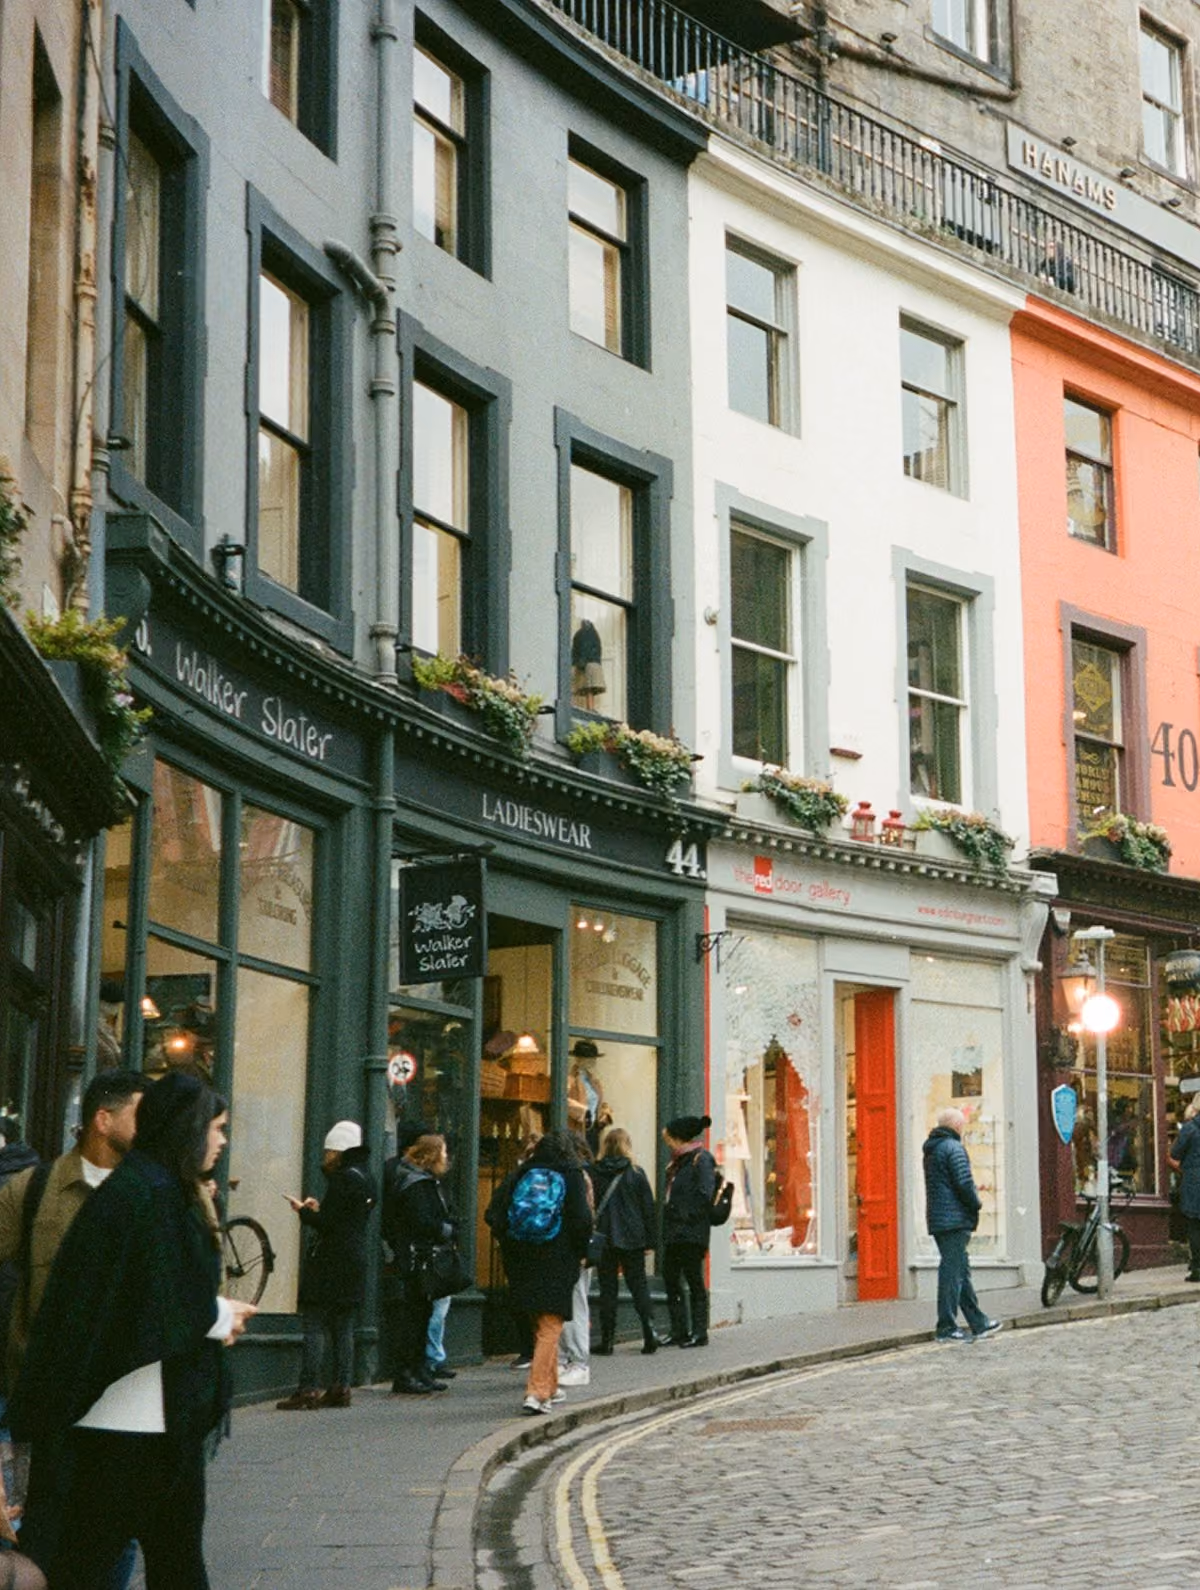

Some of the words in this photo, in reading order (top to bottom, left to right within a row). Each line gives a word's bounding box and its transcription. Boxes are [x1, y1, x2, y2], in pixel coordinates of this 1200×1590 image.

[1022, 140, 1117, 211] HANAMS
[175, 640, 248, 718] Walker
[261, 696, 333, 761] Slater
[1150, 721, 1200, 793] 40
[482, 792, 592, 849] LADIESWEAR
[754, 868, 773, 889] red
[775, 875, 802, 893] door
[808, 879, 851, 906] gallery
